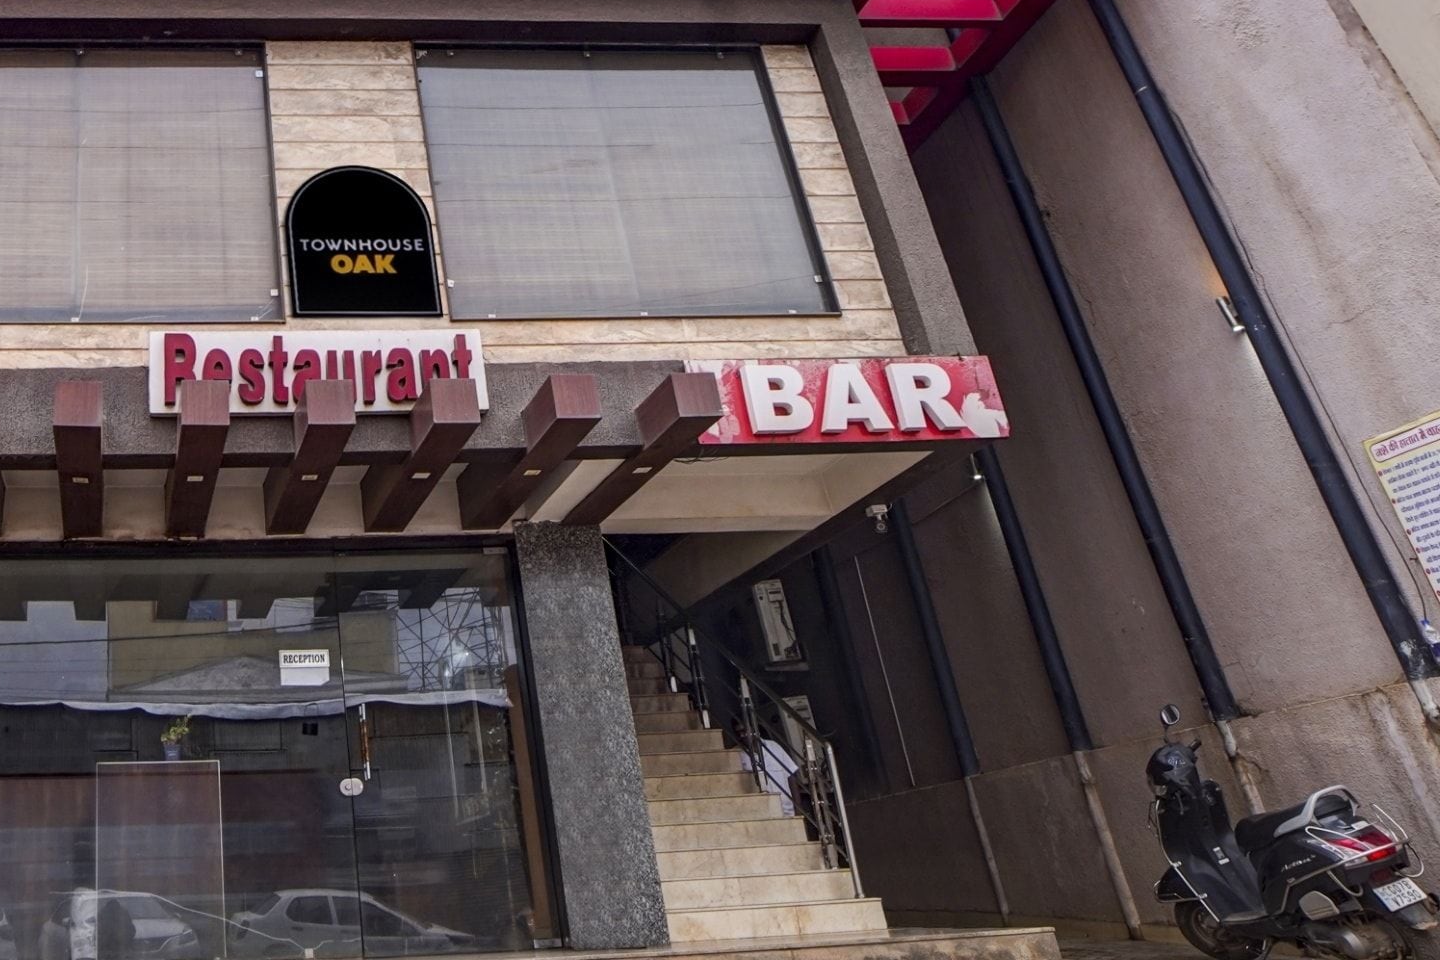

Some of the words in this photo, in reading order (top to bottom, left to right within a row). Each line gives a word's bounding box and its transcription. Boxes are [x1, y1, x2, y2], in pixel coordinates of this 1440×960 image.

[300, 239, 424, 252] TOWNHOUSE
[330, 254, 397, 274] OAK
[739, 362, 968, 435] BAR
[283, 654, 326, 664] RECEPTION
